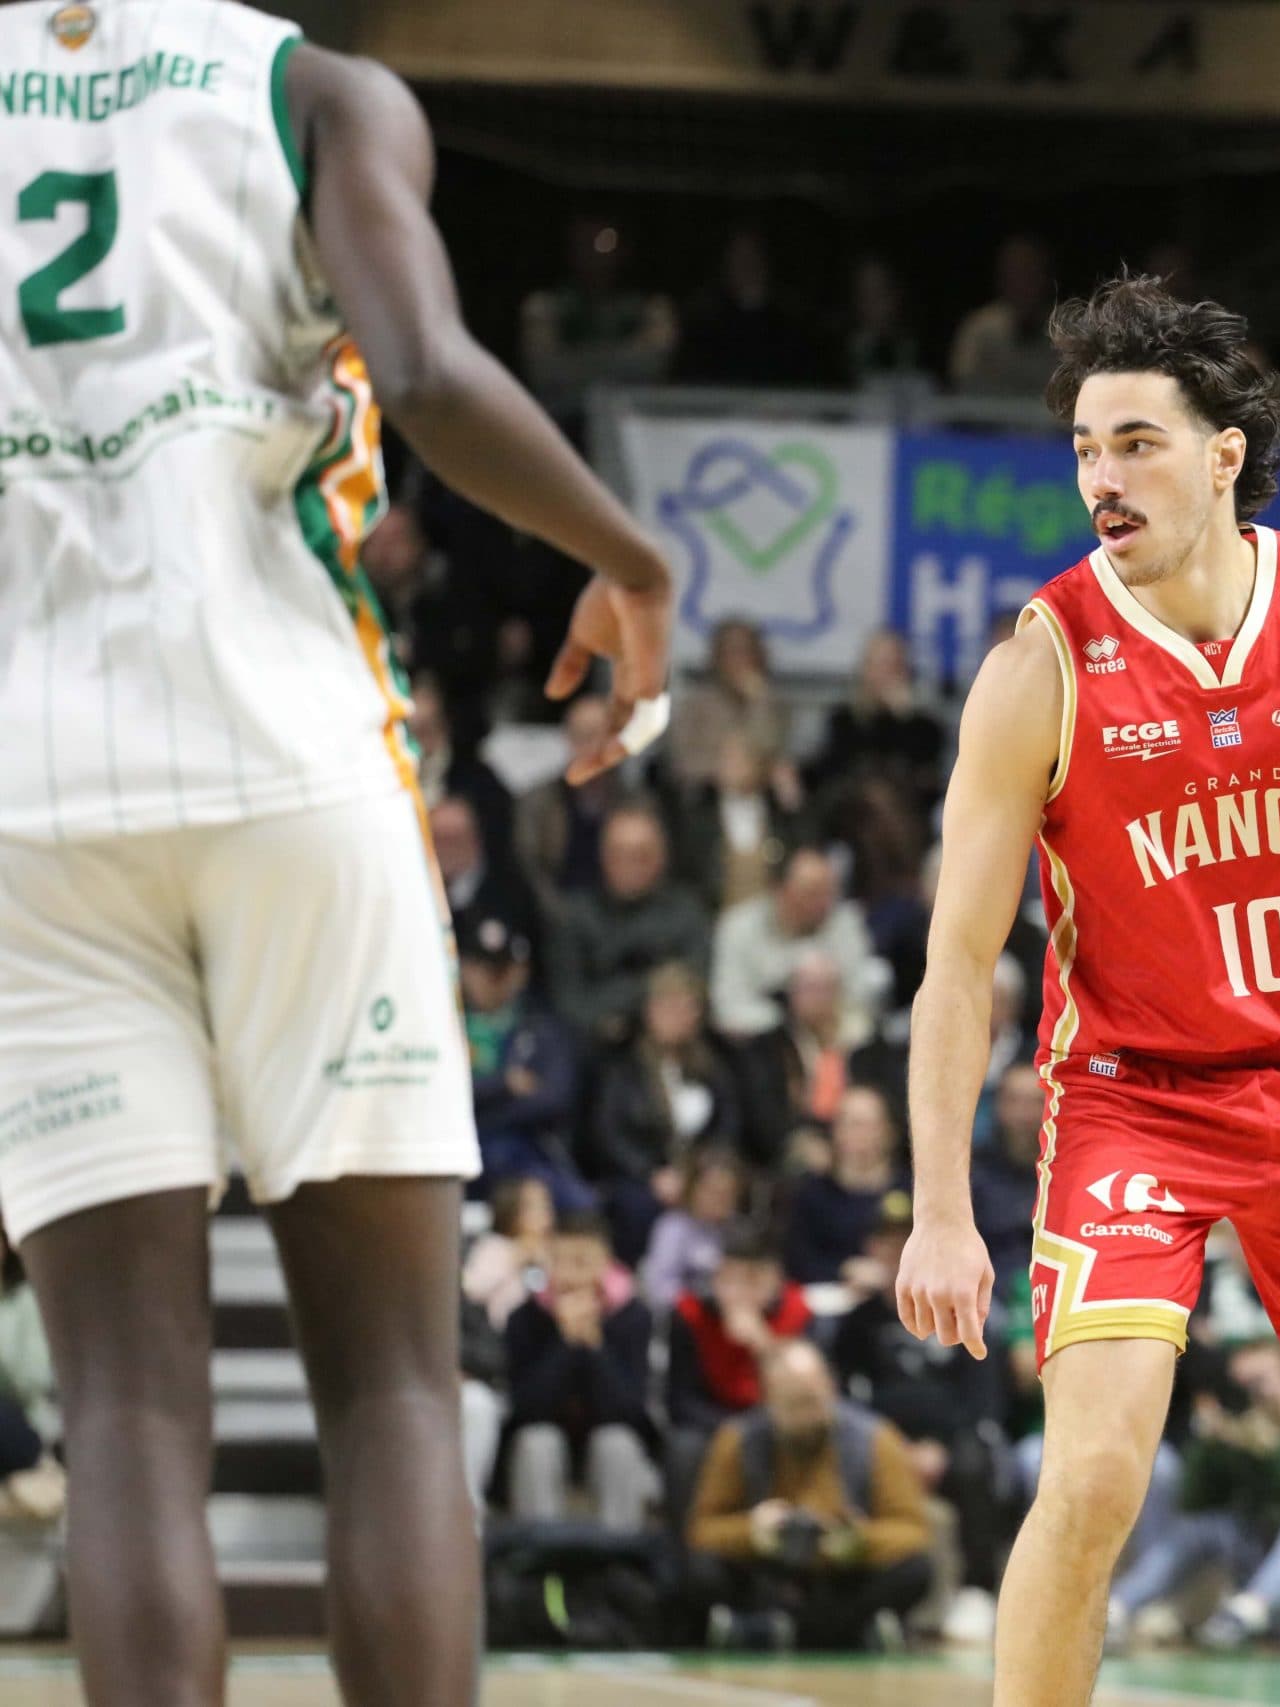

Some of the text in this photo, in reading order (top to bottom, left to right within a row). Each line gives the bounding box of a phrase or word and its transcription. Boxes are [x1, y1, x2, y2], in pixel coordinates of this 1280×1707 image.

[18, 170, 125, 347] 2
[1086, 657, 1126, 674] errea
[1102, 720, 1180, 745] FCGE
[1080, 1222, 1173, 1245] Carrefour
